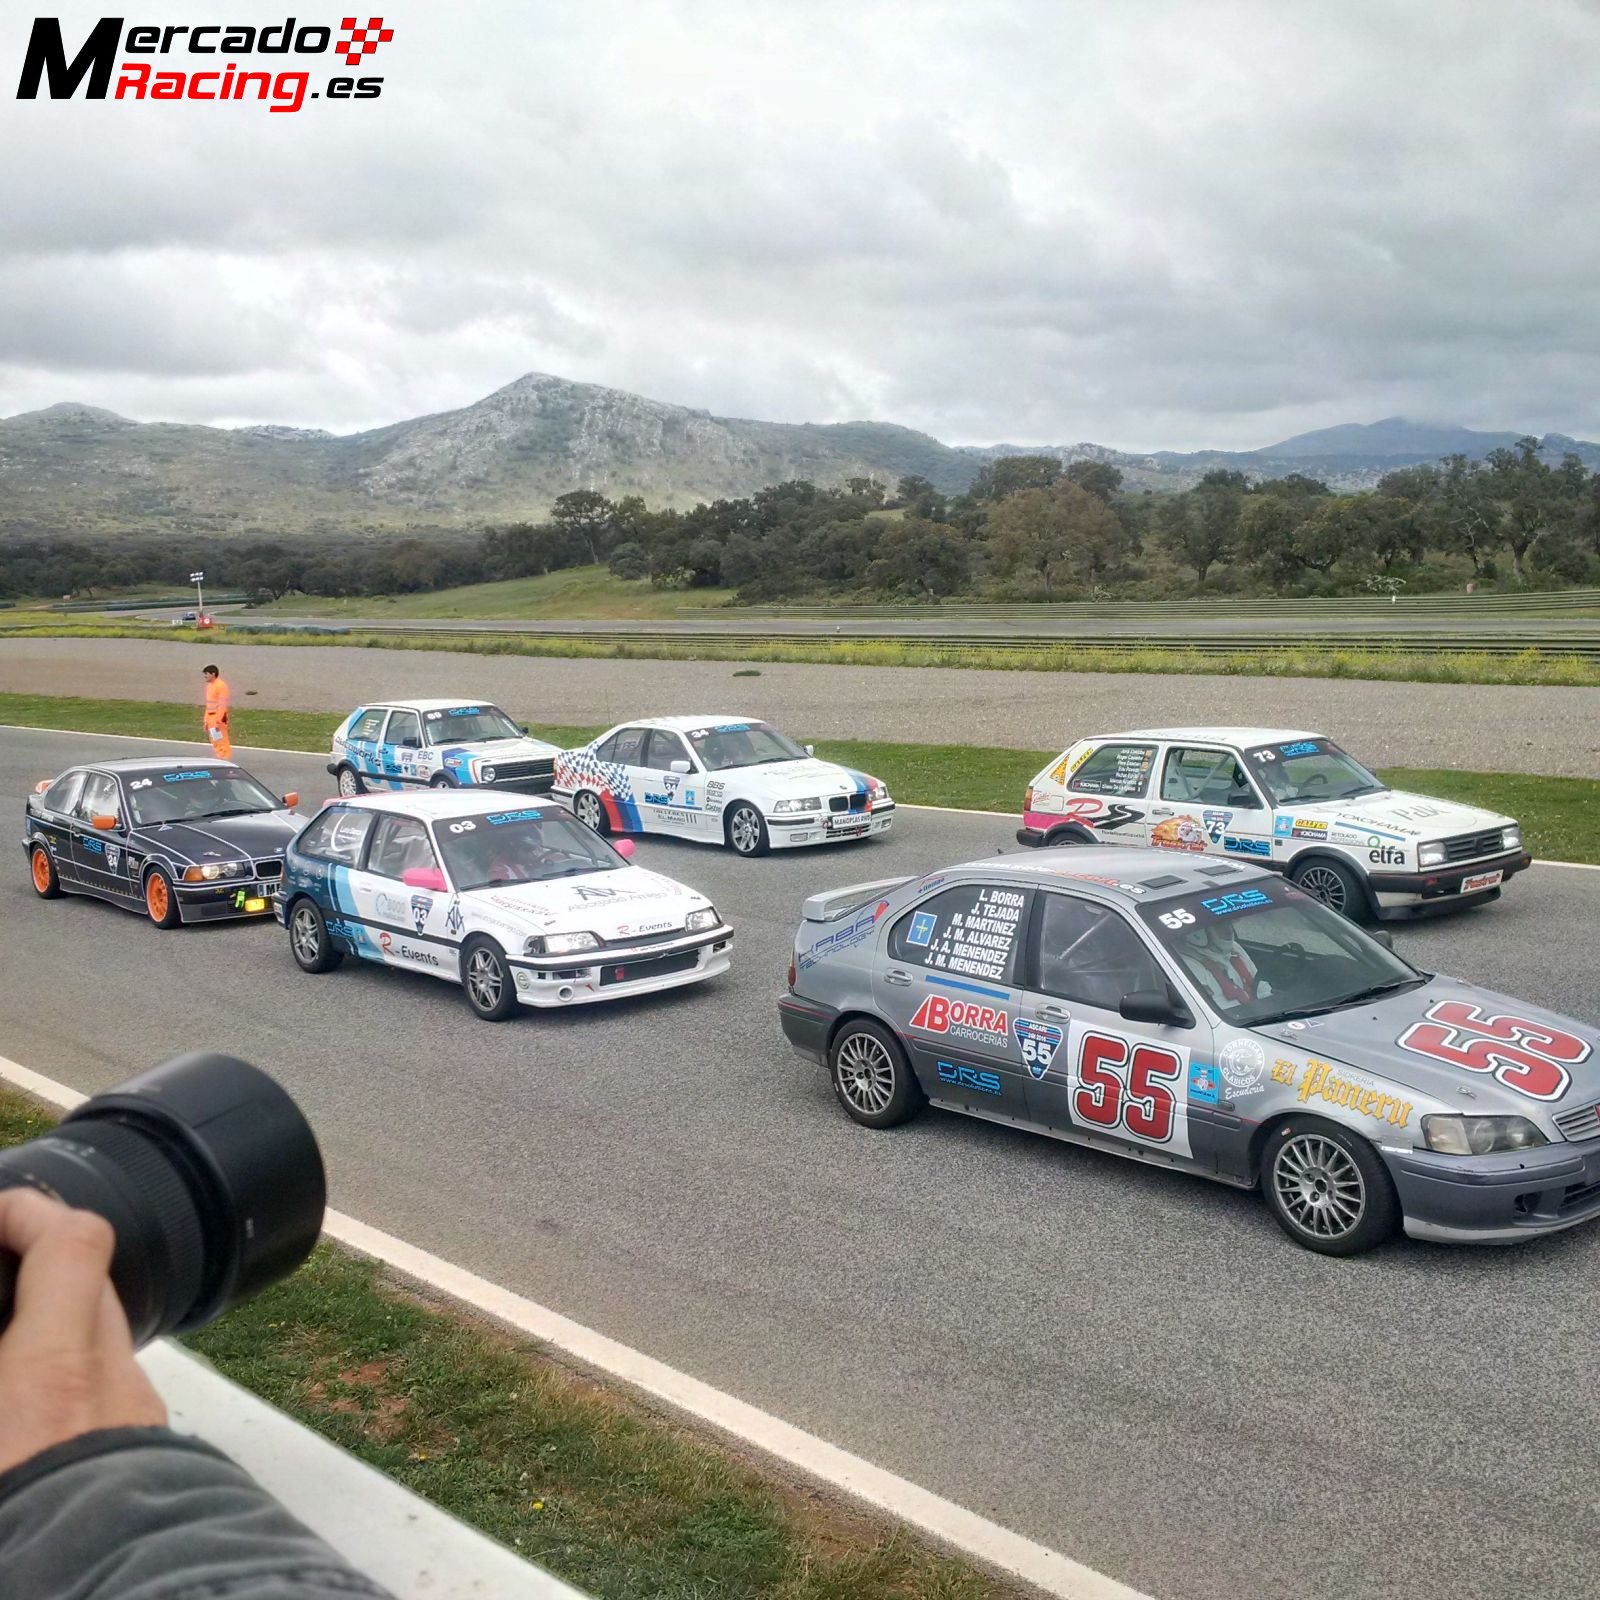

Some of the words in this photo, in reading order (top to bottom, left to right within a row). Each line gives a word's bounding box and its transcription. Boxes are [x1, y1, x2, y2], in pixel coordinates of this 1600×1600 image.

[692, 730, 709, 739] 34
[418, 750, 433, 761] EBC
[1253, 750, 1276, 763] 73
[130, 778, 153, 790] 24
[163, 770, 212, 783] DRS
[707, 780, 725, 790] BBS
[665, 783, 677, 794] 34
[449, 820, 477, 834] 03
[1206, 820, 1226, 835] 73
[1294, 819, 1329, 830] GALFER
[82, 836, 103, 851] DRS
[1224, 837, 1272, 853] DRS
[107, 854, 119, 868] 24
[1369, 846, 1405, 864] elfa
[979, 889, 989, 902] L.
[990, 891, 1025, 908] BORRA
[1201, 889, 1268, 912] DRS
[414, 907, 426, 925] 03
[971, 902, 980, 915] J.
[983, 904, 1020, 922] TEJADA
[1158, 908, 1196, 930] 55
[952, 913, 963, 926] M.
[965, 915, 1017, 936] MARTINEZ
[943, 926, 952, 939] J.
[953, 929, 965, 941] M.
[967, 931, 1012, 951] ALVAREZ
[930, 939, 939, 951] J.
[940, 941, 951, 954] A.
[953, 943, 1008, 965] MENENDEZ
[924, 952, 933, 965] J.
[935, 954, 946, 967] M.
[948, 957, 1004, 980] MENENDEZ
[925, 996, 1008, 1035] BORRA
[950, 1025, 1008, 1048] CARROCERIAS
[1022, 1039, 1051, 1065] 55
[1395, 1000, 1594, 1103] 55
[937, 1061, 1001, 1090] DRS
[1223, 1067, 1256, 1087] CLASICOS
[1270, 1058, 1297, 1086] El
[1336, 1069, 1375, 1087] SIDRERIA
[1073, 1030, 1182, 1144] 55
[1225, 1082, 1265, 1100] Escuderia
